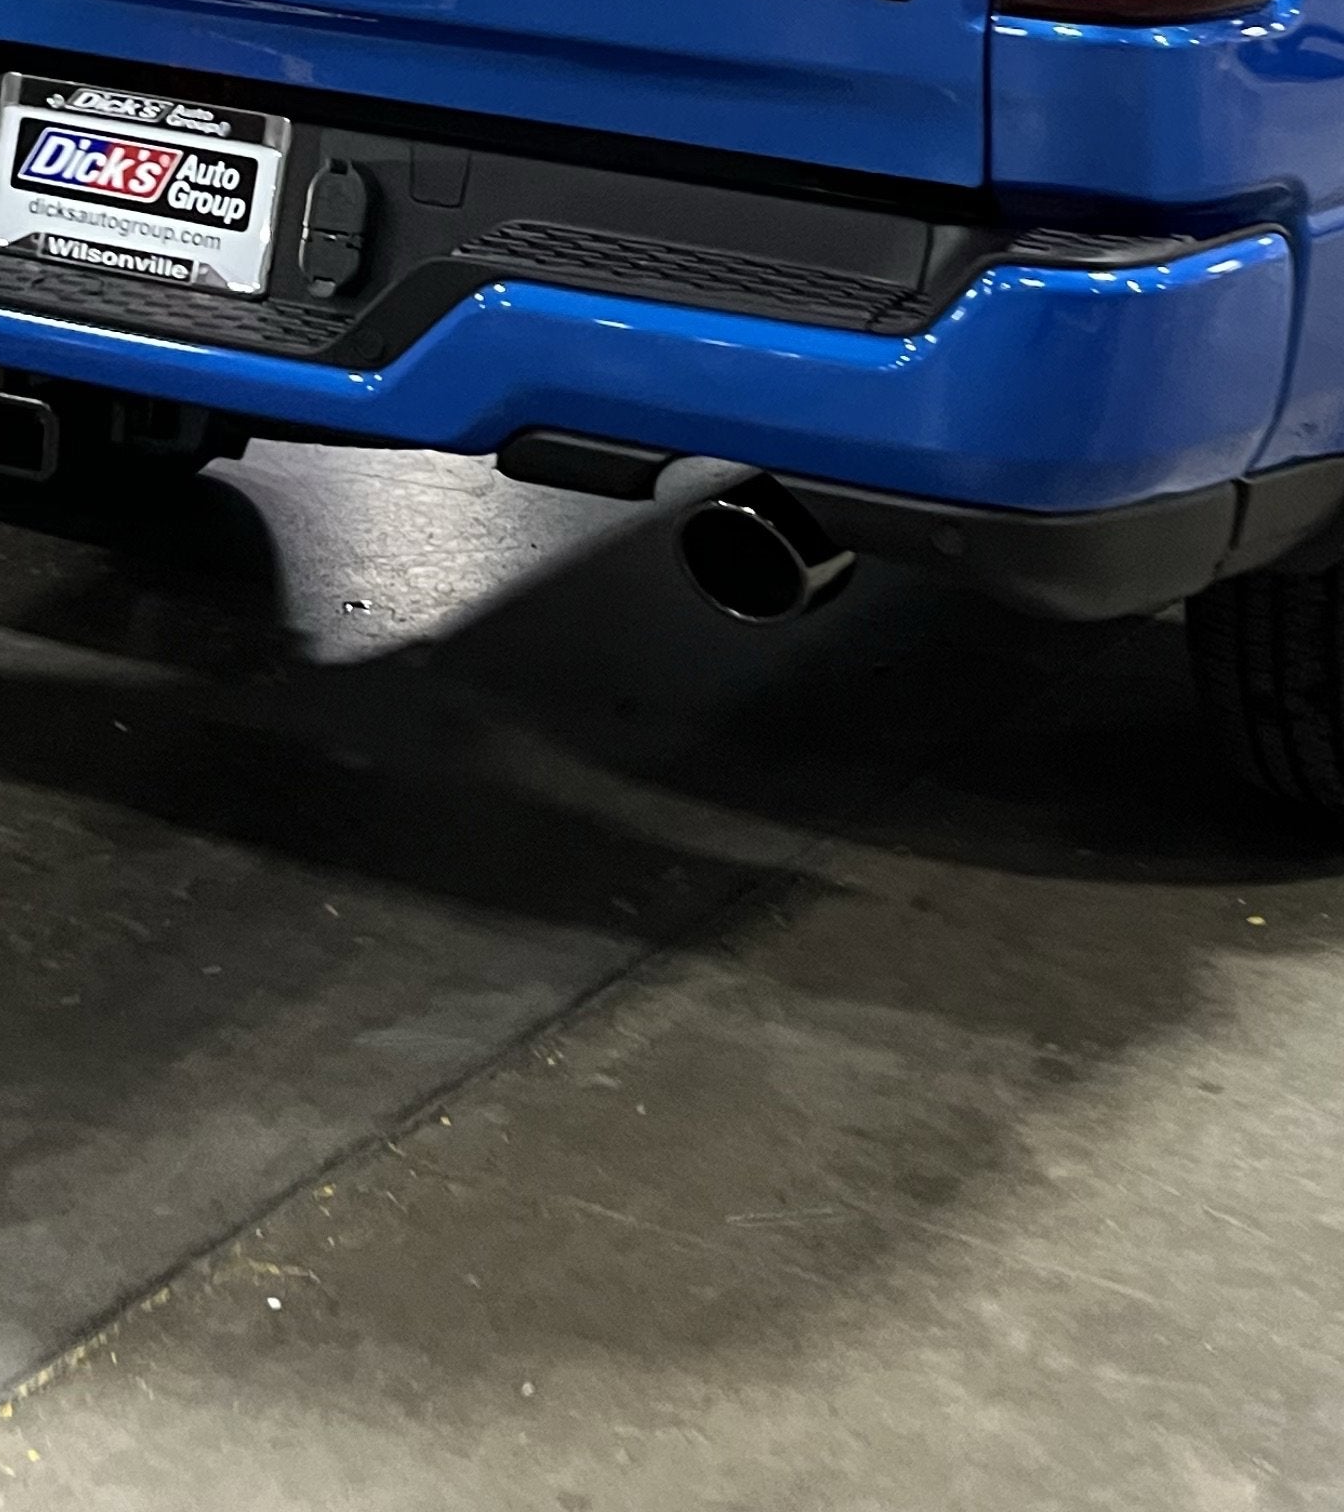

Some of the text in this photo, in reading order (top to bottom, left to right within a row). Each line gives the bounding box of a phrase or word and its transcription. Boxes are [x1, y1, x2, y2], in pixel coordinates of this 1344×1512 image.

[31, 135, 164, 194] Dick's
[176, 154, 240, 190] Auto
[29, 198, 222, 250] dicksautogroup.com
[167, 180, 246, 224] Group
[48, 236, 190, 280] Wilsonville
